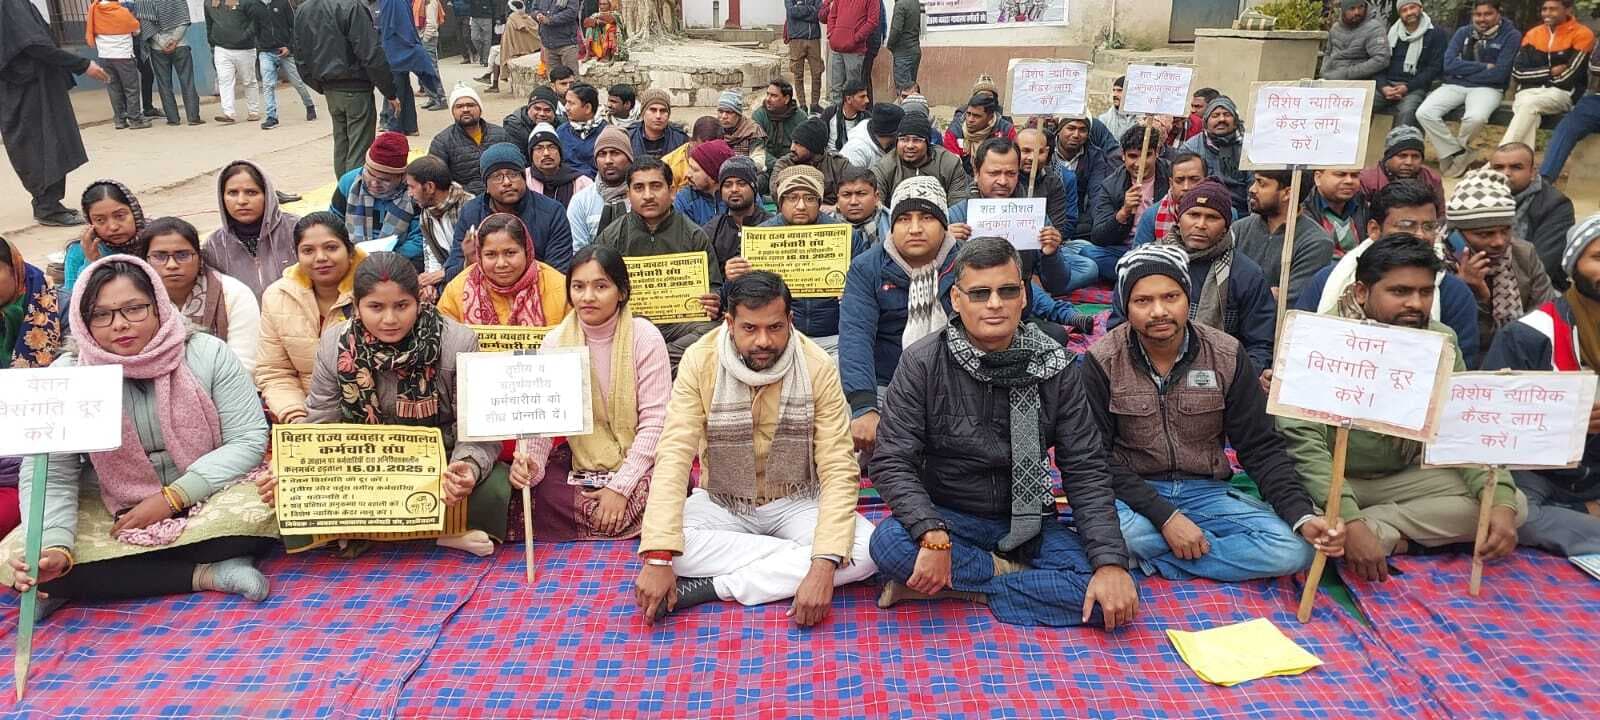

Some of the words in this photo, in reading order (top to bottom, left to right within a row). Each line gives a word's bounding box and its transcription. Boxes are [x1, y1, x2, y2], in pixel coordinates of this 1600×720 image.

[1268, 92, 1302, 109] विशेष
[1309, 93, 1354, 109] न्यायिक
[1275, 113, 1307, 130] कैडर
[1313, 118, 1342, 134] लागू
[1345, 329, 1389, 354] वेतन
[1307, 350, 1378, 380] विसंगति
[1388, 368, 1416, 389] दूर
[1451, 384, 1495, 401] विशेष
[1503, 385, 1568, 402] न्यायिक
[77, 400, 104, 418] दूर
[1461, 406, 1502, 424] कैडर
[1510, 411, 1548, 431] लागू
[281, 431, 312, 442] बिहार
[315, 432, 342, 442] राज्य
[345, 433, 384, 442] व्यवहार
[388, 433, 437, 443] न्यायालय
[319, 443, 376, 454] कर्मचारी
[382, 443, 405, 454] संघ
[346, 464, 423, 472] 16.01.2025
